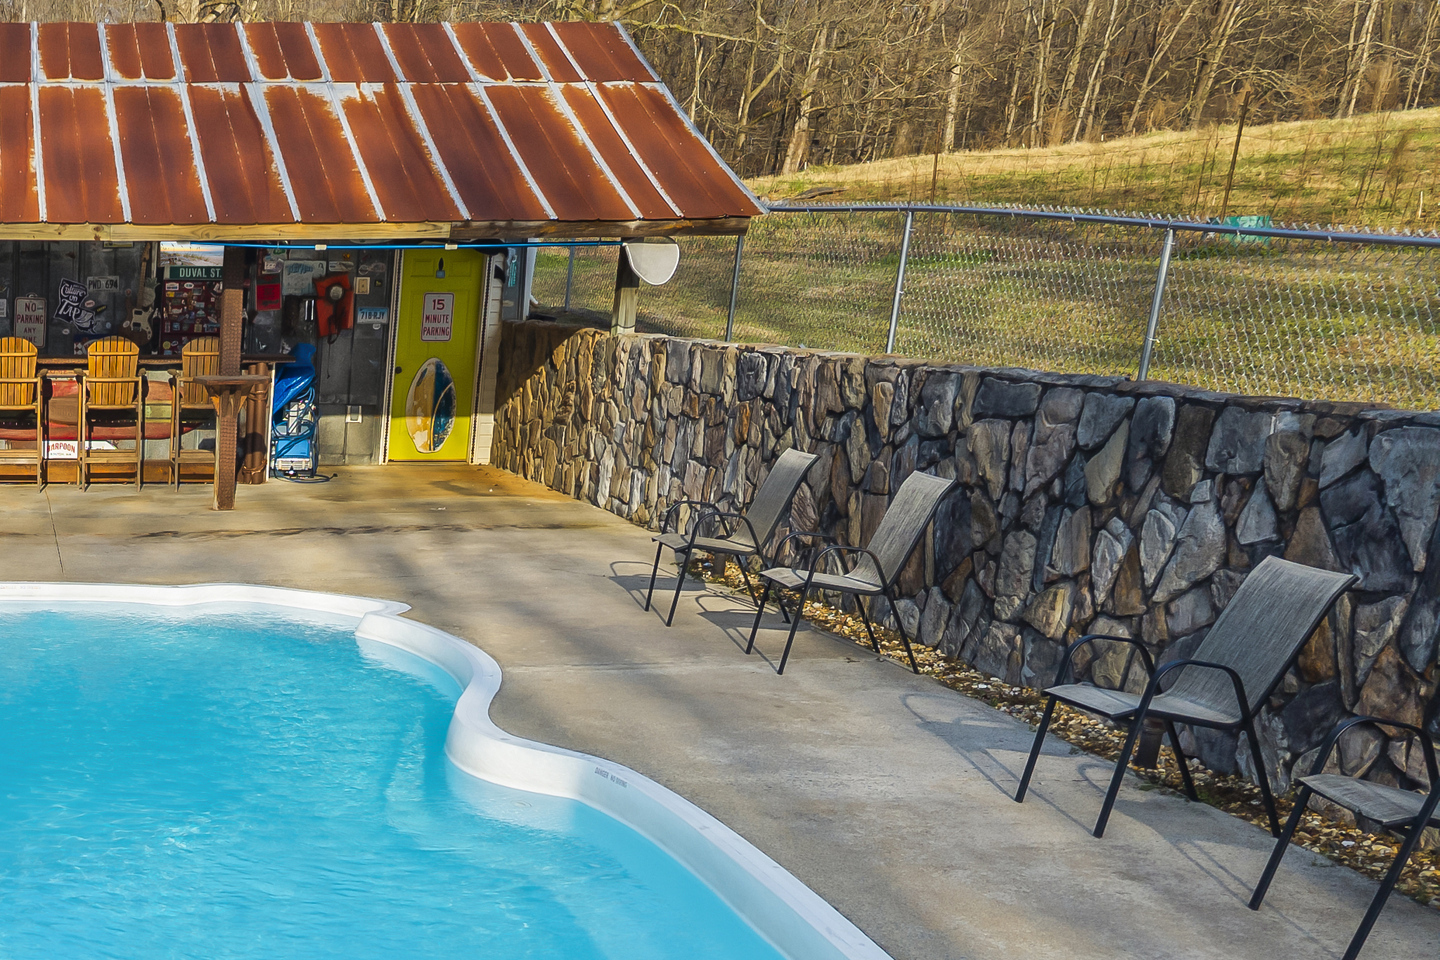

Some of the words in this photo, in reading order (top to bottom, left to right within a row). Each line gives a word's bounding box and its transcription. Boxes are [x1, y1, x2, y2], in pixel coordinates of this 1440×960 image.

[179, 268, 207, 278] DUVAL
[210, 268, 222, 278] ST.
[105, 280, 118, 289] 694
[24, 303, 36, 312] NO
[432, 299, 445, 310] 15
[16, 314, 43, 324] PARKING
[425, 314, 449, 323] MINUTE
[423, 327, 449, 336] PARKING
[595, 767, 609, 779] DANGER
[610, 774, 616, 782] NO
